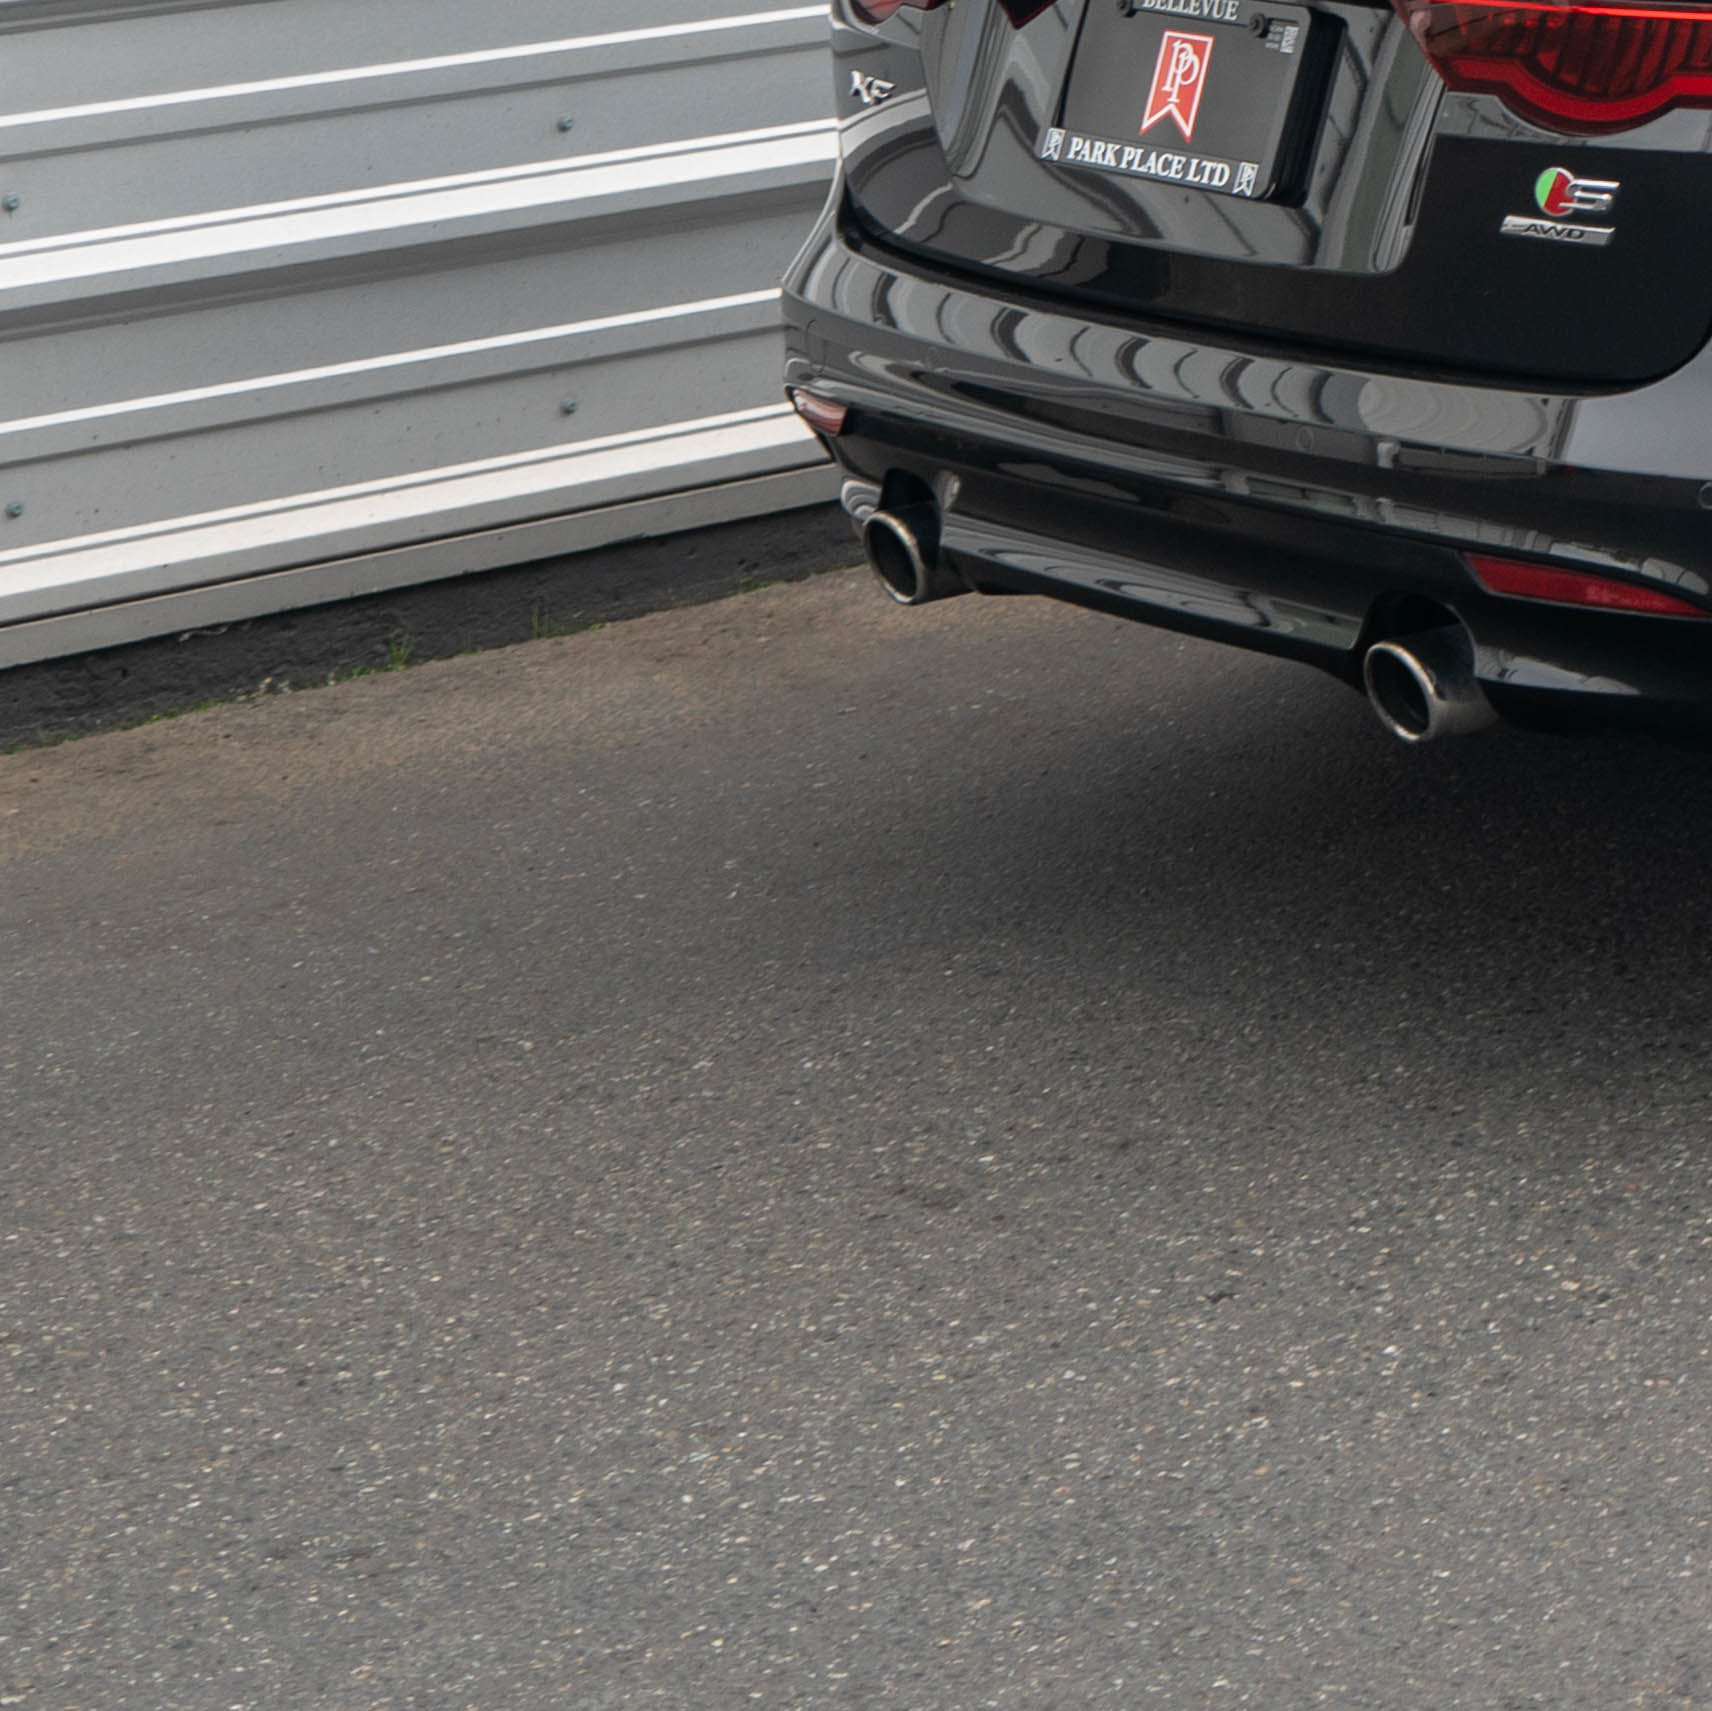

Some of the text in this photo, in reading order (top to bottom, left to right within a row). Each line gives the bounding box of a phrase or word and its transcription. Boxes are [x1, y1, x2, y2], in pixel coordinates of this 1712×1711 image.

[1066, 136, 1231, 187] PARK PLACE LTD
[1524, 222, 1585, 240] AWD
